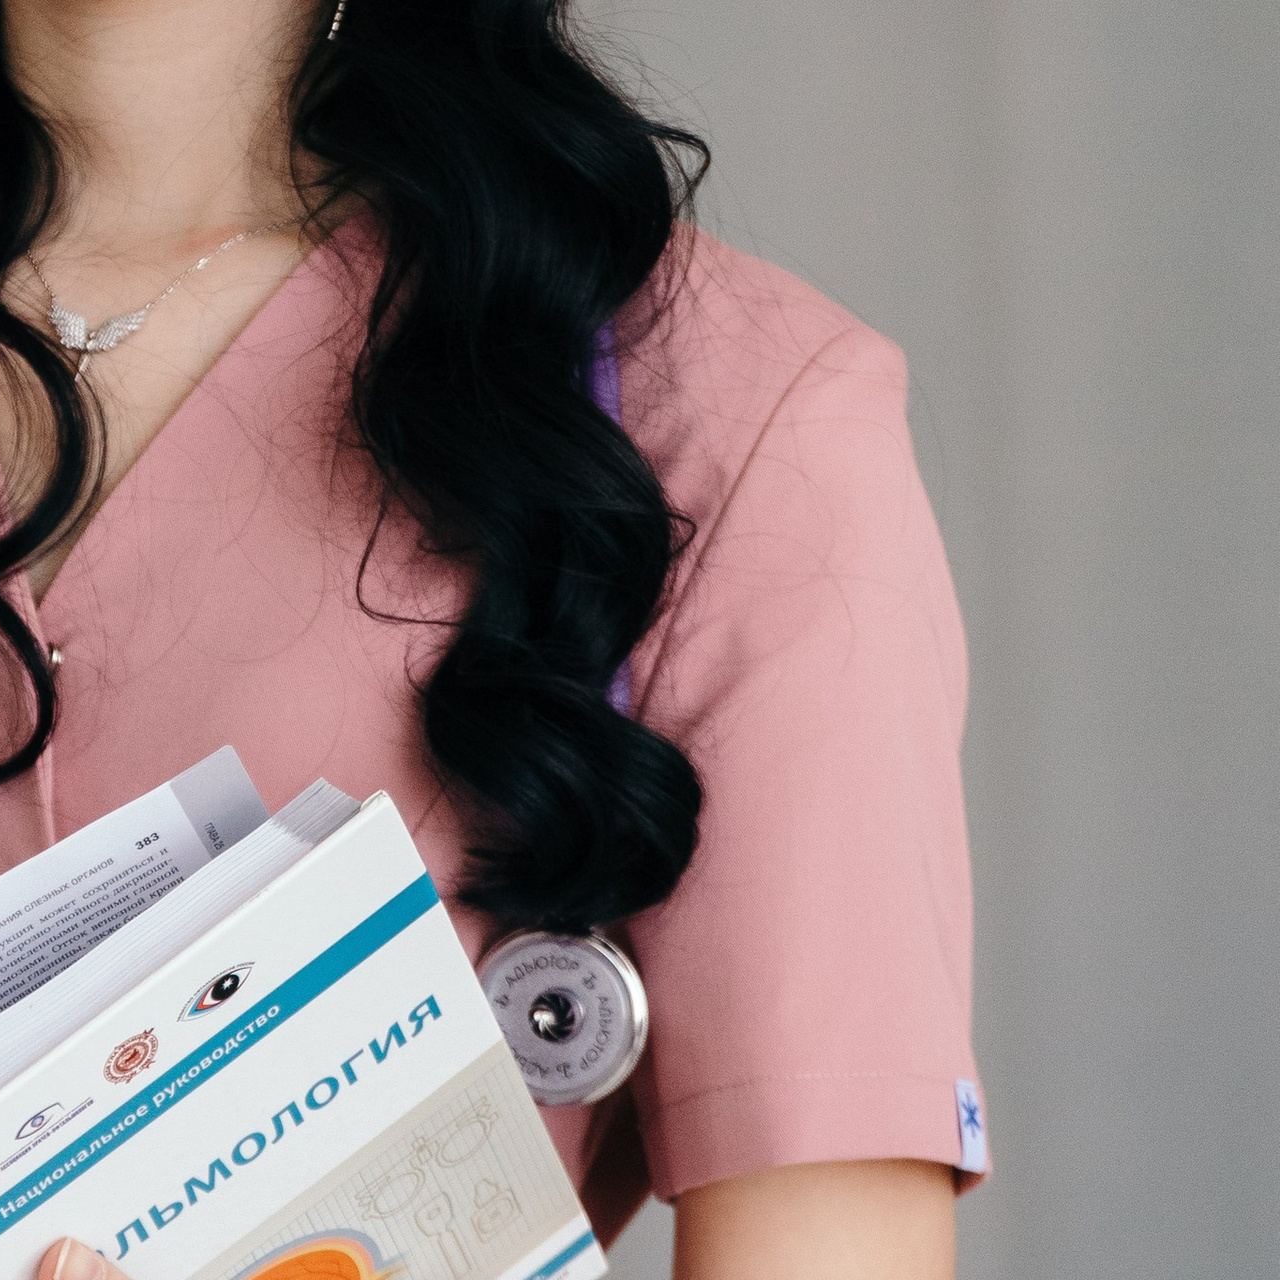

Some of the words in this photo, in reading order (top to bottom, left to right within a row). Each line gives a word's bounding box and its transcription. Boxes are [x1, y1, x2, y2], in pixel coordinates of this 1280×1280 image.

[135, 833, 160, 850] 383
[6, 893, 109, 957] серозно-гнойного
[112, 858, 173, 898] дакриоци-
[23, 882, 70, 913] СЛЕЗНЫХ
[71, 857, 115, 886] ОРГАНОВ
[39, 898, 77, 924] может
[82, 855, 155, 900] сохраняться
[159, 847, 169, 857] и
[51, 929, 88, 954] Отток
[91, 896, 146, 930] венозной
[149, 875, 185, 902] крови
[82, 894, 129, 924] ветвями
[133, 865, 179, 896] глазной
[26, 946, 87, 984] глазницы,
[86, 922, 121, 947] также
[0, 1104, 149, 1219] Национальное
[152, 1004, 281, 1108] руководство
